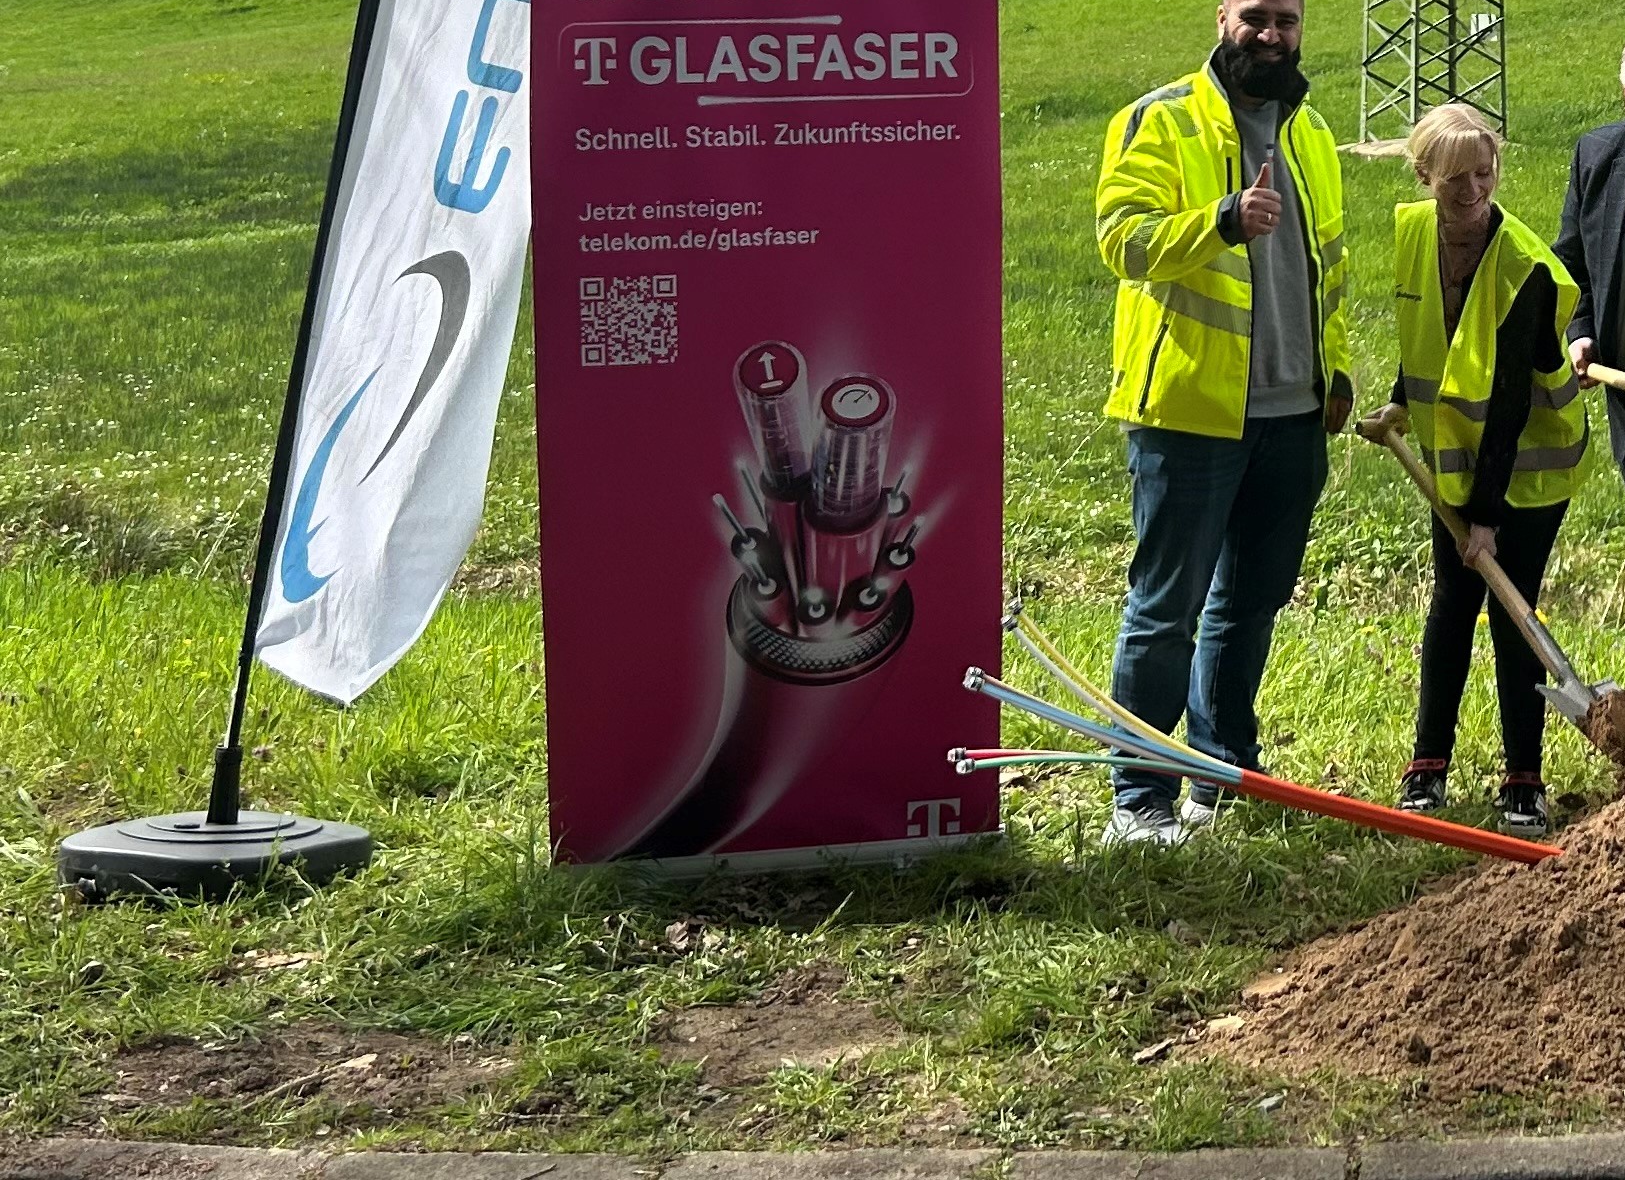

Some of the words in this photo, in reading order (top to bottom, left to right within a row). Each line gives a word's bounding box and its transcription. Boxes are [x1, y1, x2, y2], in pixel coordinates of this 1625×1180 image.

[629, 32, 958, 85] GLASFASER
[575, 126, 678, 151] Schnell.
[685, 124, 767, 148] Stabil.
[774, 119, 961, 145] Zukunftssicher.
[578, 202, 637, 222] Jetzt
[642, 198, 763, 221] einsteigen:
[578, 226, 820, 253] telekom.de/glasfaser
